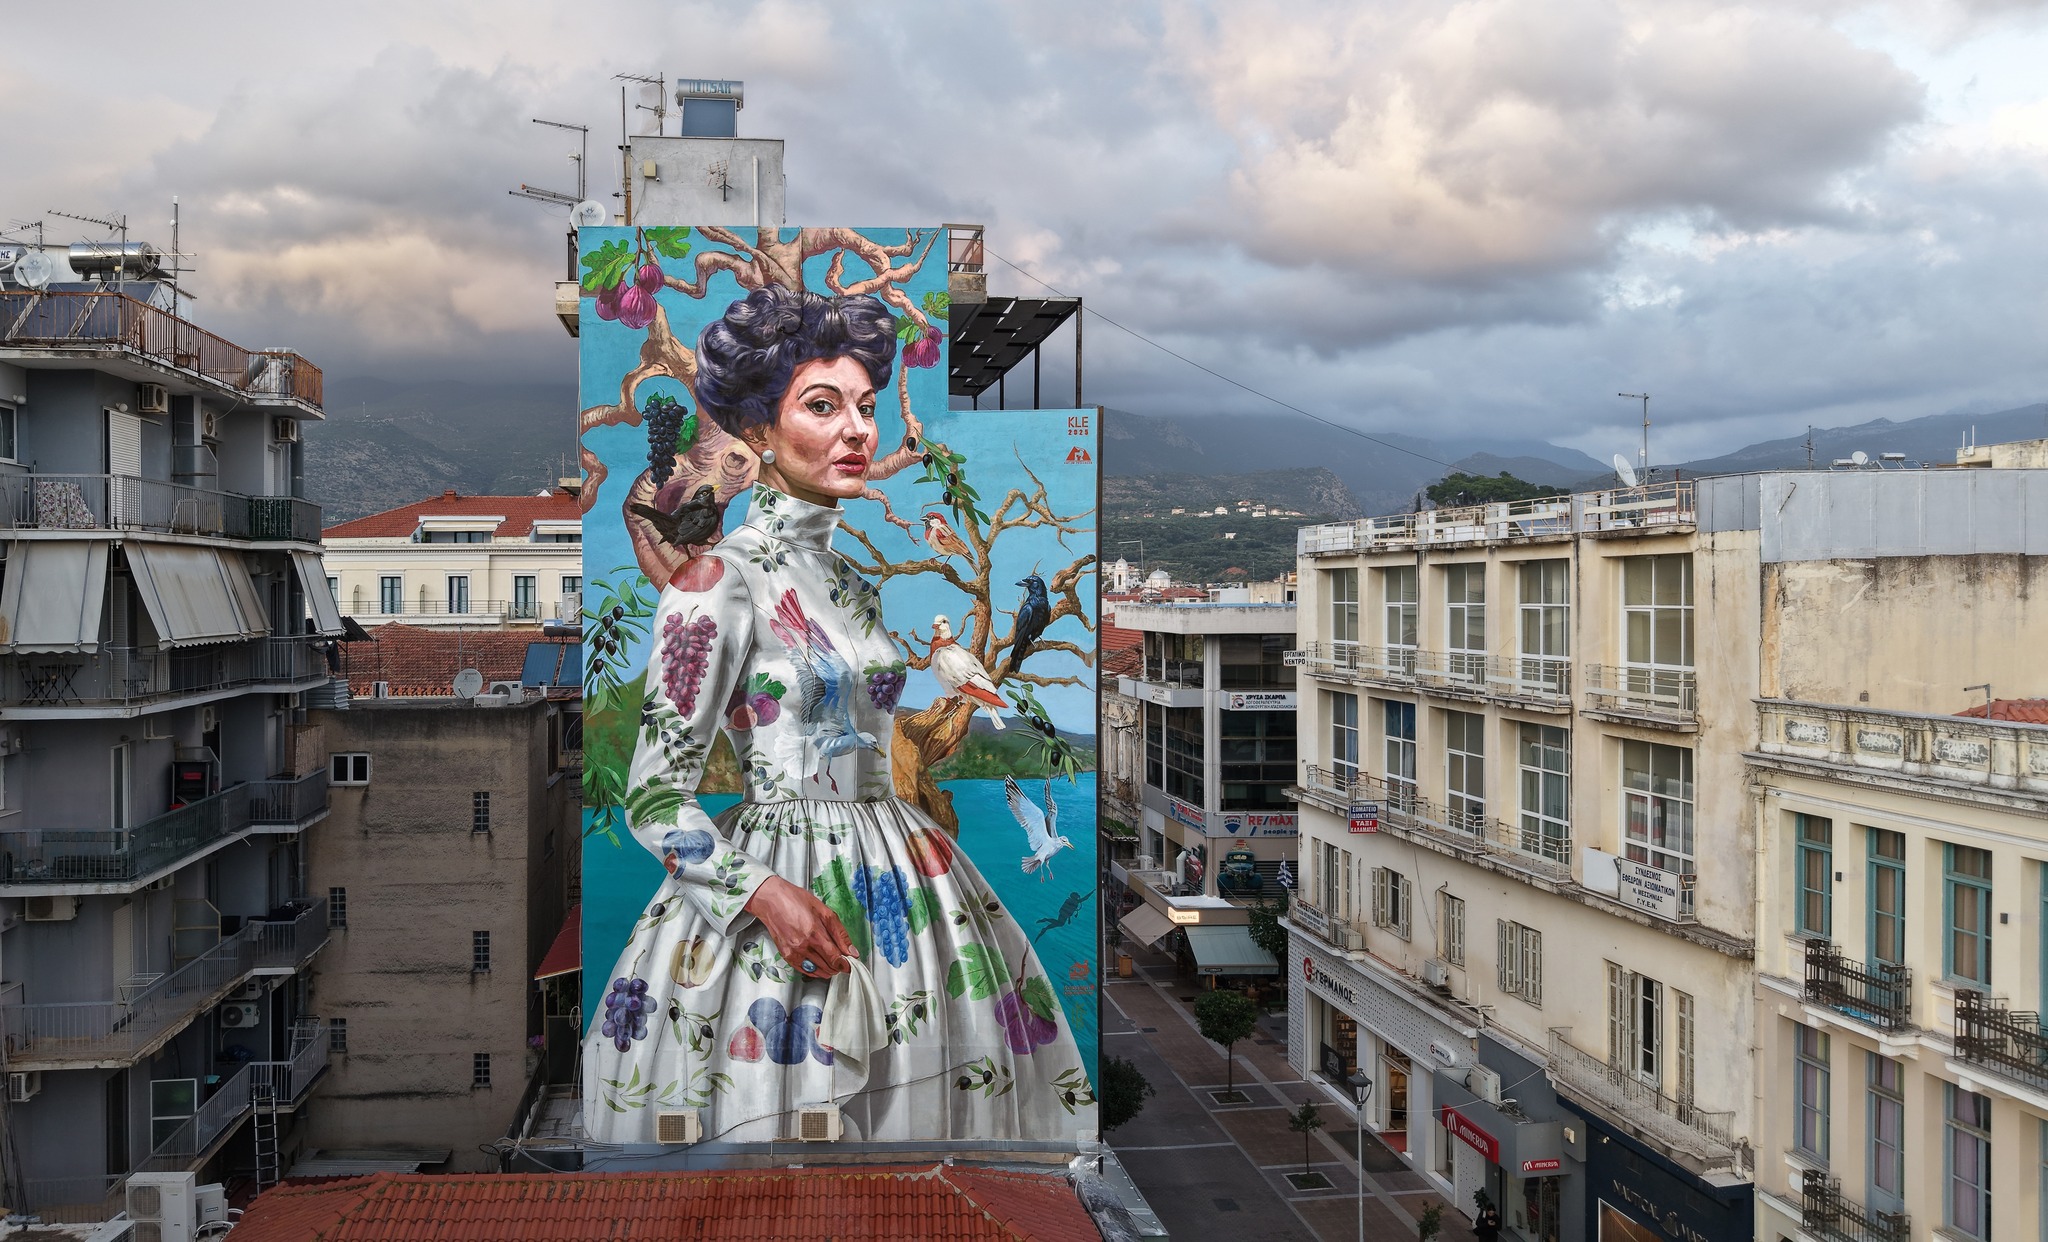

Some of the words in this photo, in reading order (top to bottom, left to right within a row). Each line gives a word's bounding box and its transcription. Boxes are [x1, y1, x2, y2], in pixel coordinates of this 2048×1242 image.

[1068, 416, 1089, 428] KLE
[1248, 815, 1293, 826] RE/MAX
[1635, 867, 1661, 881] ΣΥΝΔΕΣΜΟΣ
[1622, 873, 1642, 886] ΕΦΕΔΡΩΝ
[1644, 881, 1675, 897] ΑΞΙΩΜΑΤΙΚΩΝ
[1638, 889, 1663, 903] ΜΕΣΣΗΝΙΑΣ
[1315, 969, 1355, 1004] ΓΕΡΜΑΝΟΣ
[1459, 1124, 1489, 1154] MINERVA
[1534, 1160, 1559, 1168] MINERVA
[1613, 1179, 1660, 1221] NAUTICAL
